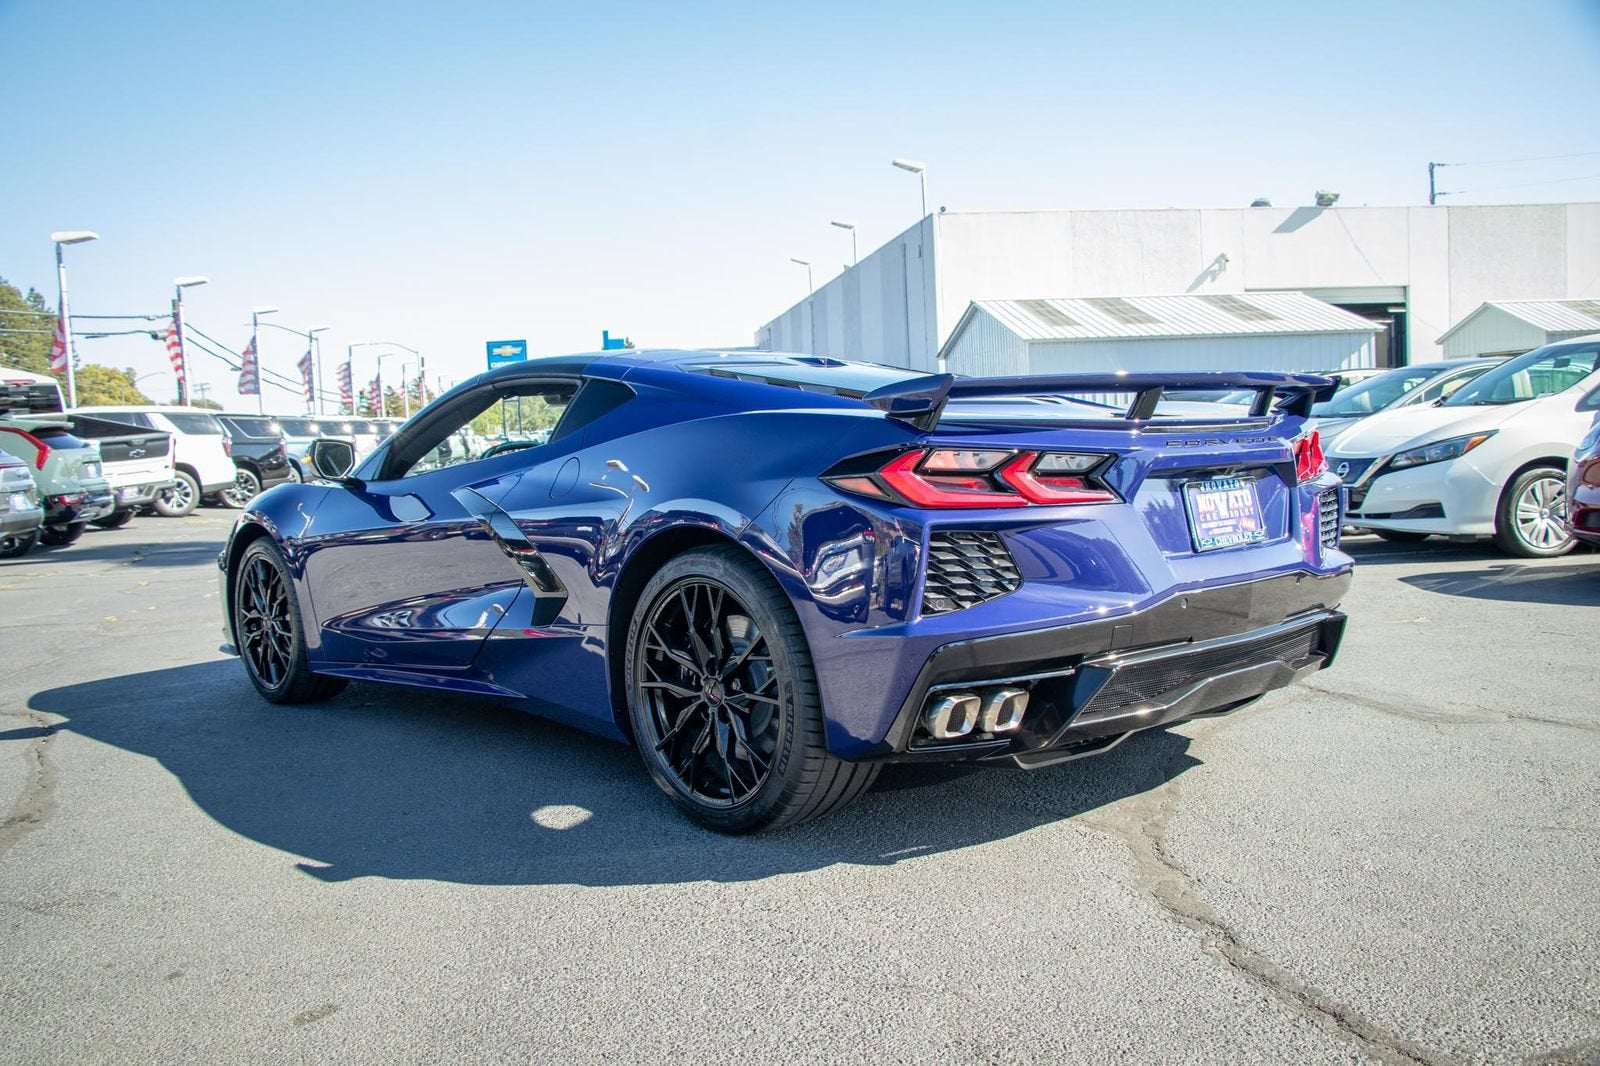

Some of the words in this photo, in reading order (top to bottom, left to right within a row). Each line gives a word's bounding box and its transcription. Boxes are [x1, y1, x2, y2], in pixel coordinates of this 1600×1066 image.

[1166, 436, 1278, 448] CORVETTE
[1196, 489, 1252, 518] NOVATO
[778, 703, 794, 774] MICHELIN
